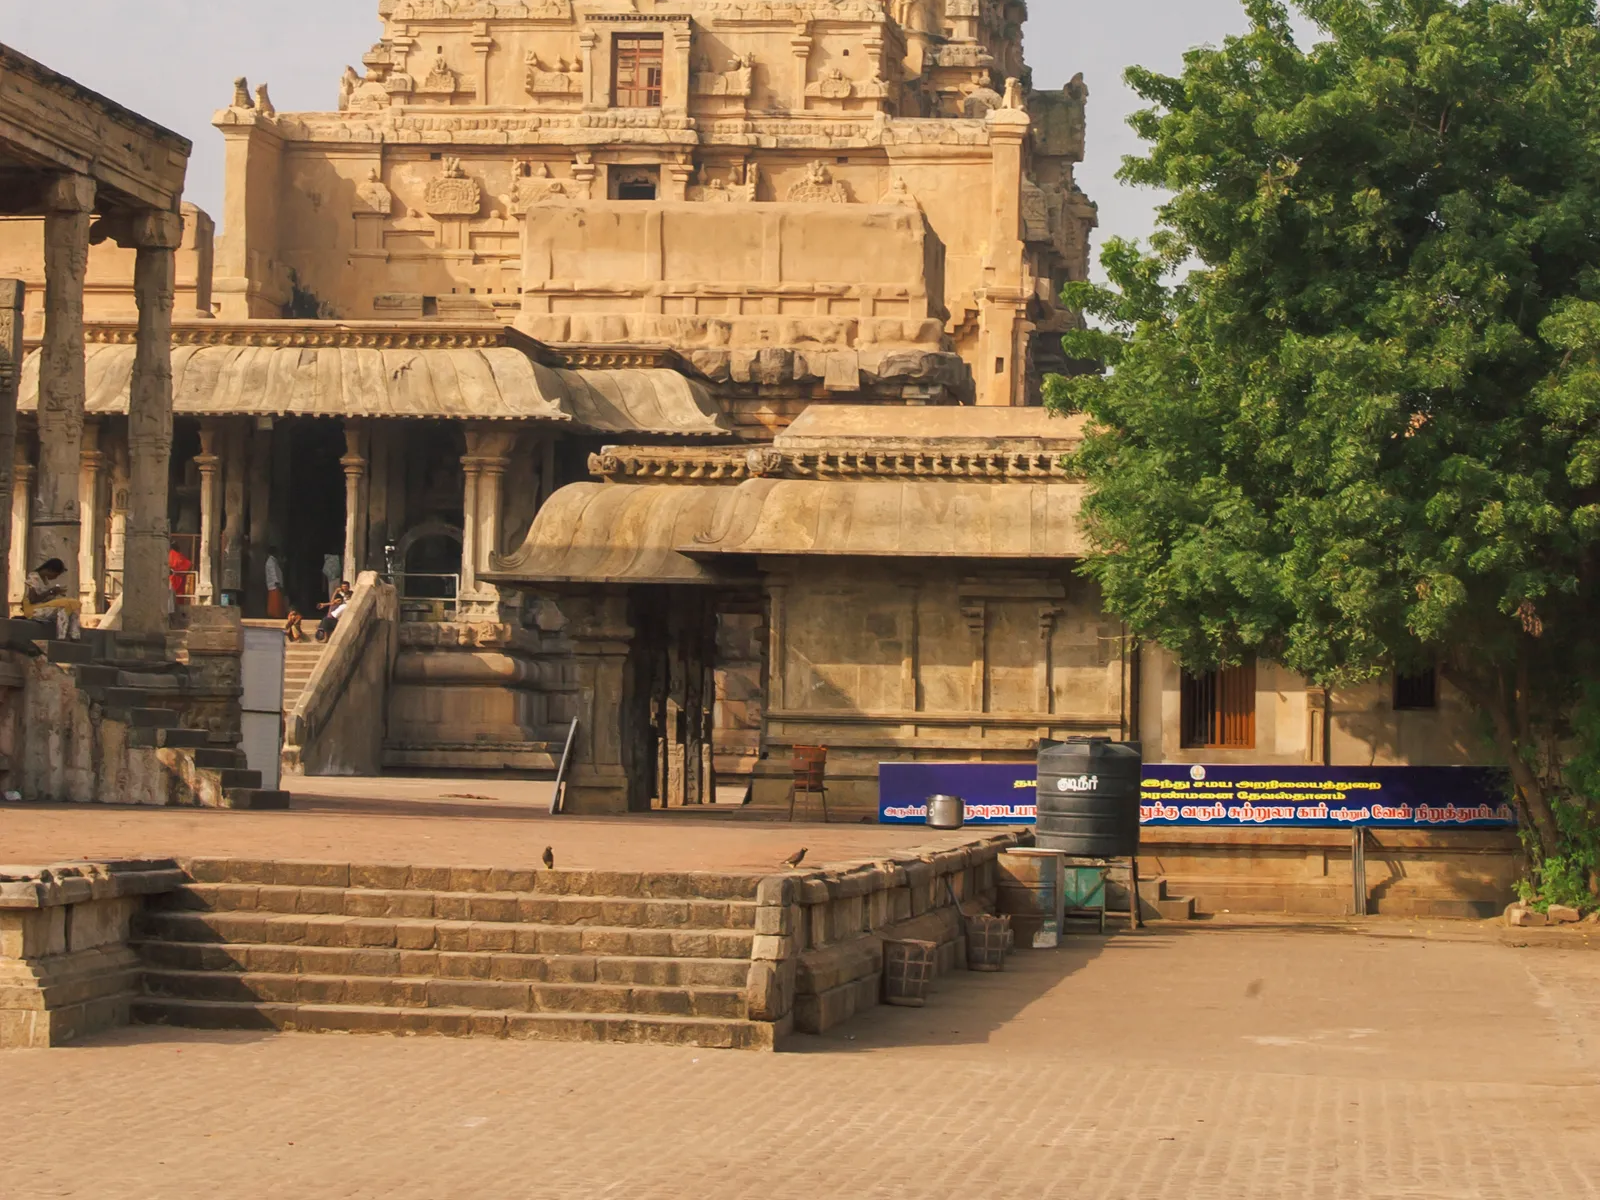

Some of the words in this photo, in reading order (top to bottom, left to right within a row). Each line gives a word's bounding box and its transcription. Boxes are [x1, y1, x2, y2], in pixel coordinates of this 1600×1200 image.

[1057, 775, 1098, 791] குடிநீர்
[1140, 779, 1190, 790] இந்து
[1235, 780, 1382, 790] அறநிலையத்துறை
[1237, 791, 1346, 800] தேவஸ்தானம்
[884, 805, 927, 818] அருள்மி
[1181, 801, 1226, 821] வரும்
[1228, 802, 1295, 822] சுற்றுலா
[1297, 802, 1329, 819] கார்
[1330, 807, 1370, 821] மற்றும்
[1371, 803, 1413, 820] வேன்
[1415, 803, 1512, 822] நிறுத்துமிடம்
